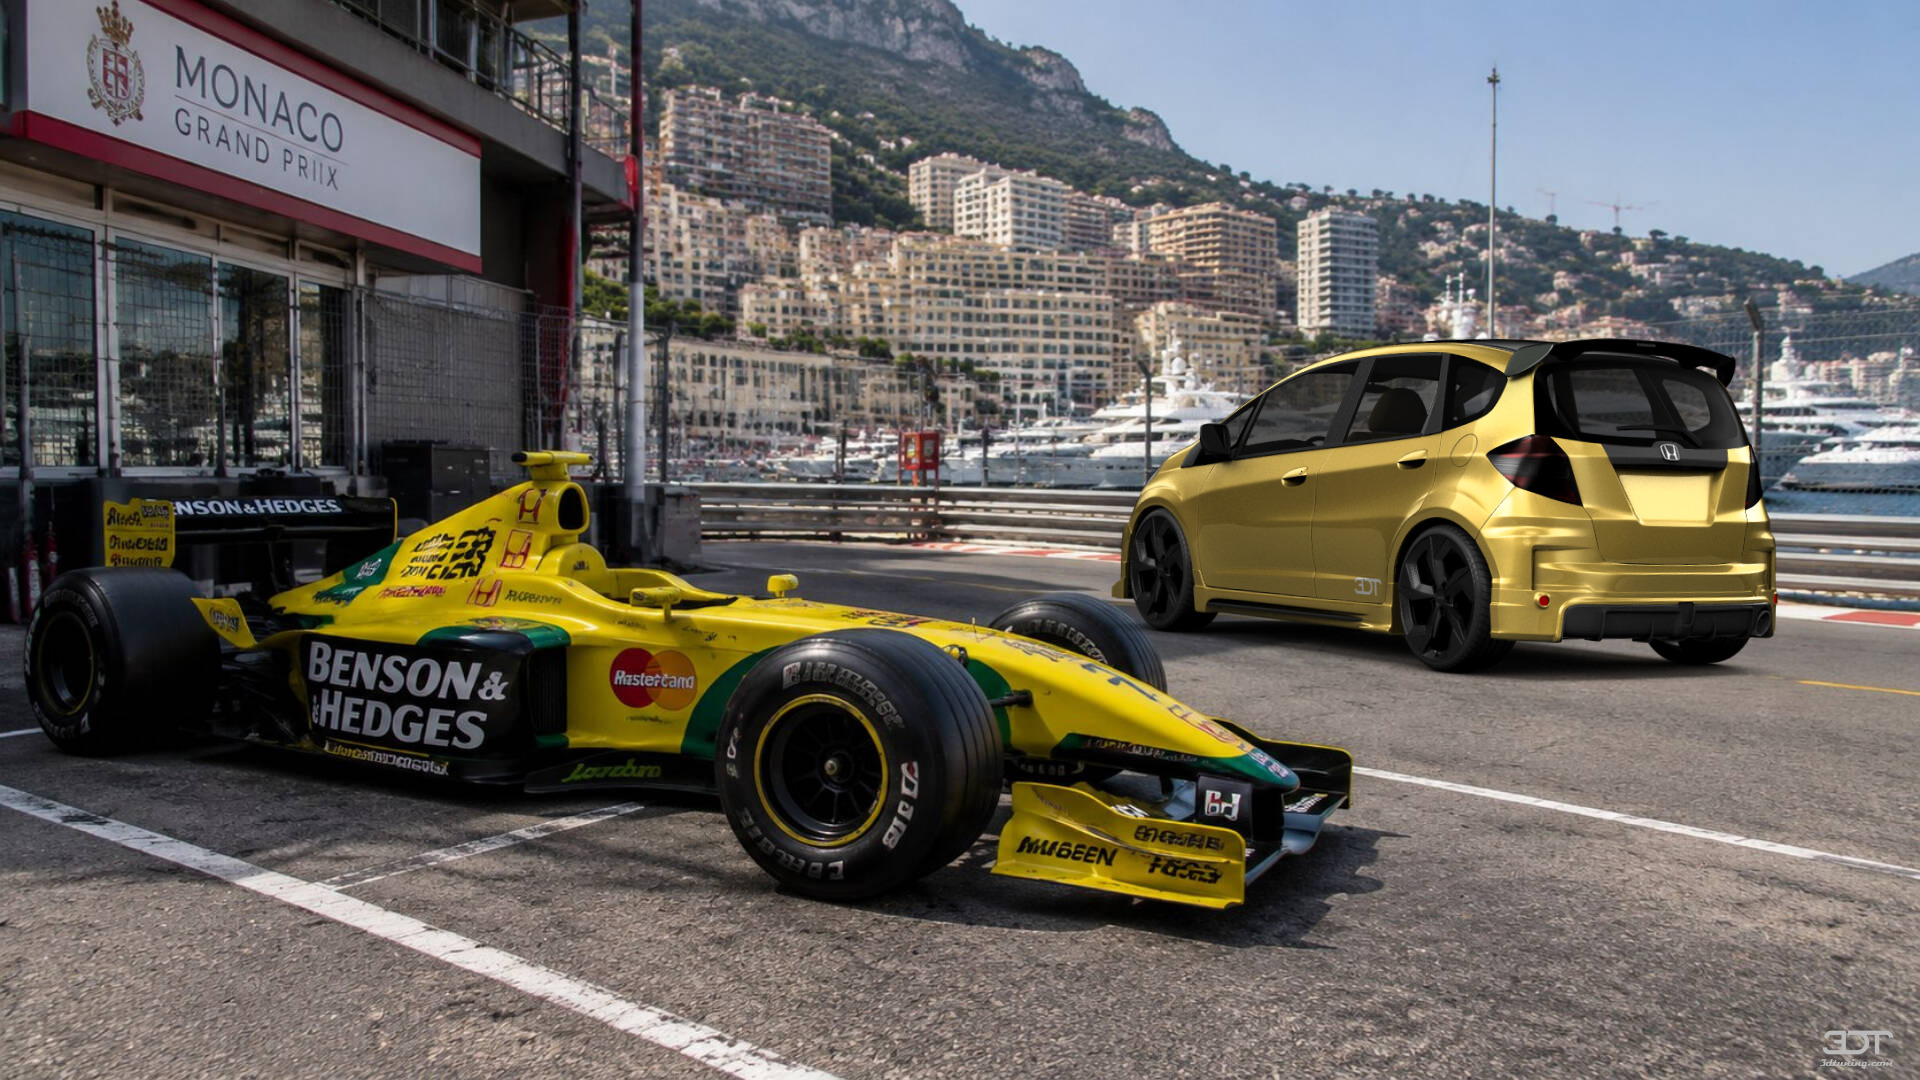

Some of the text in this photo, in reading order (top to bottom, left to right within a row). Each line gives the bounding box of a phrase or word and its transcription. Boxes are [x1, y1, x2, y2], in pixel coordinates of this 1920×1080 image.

[175, 44, 343, 153] MONACO
[175, 107, 339, 191] GRAND PRIIX
[1354, 576, 1382, 596] 3DT
